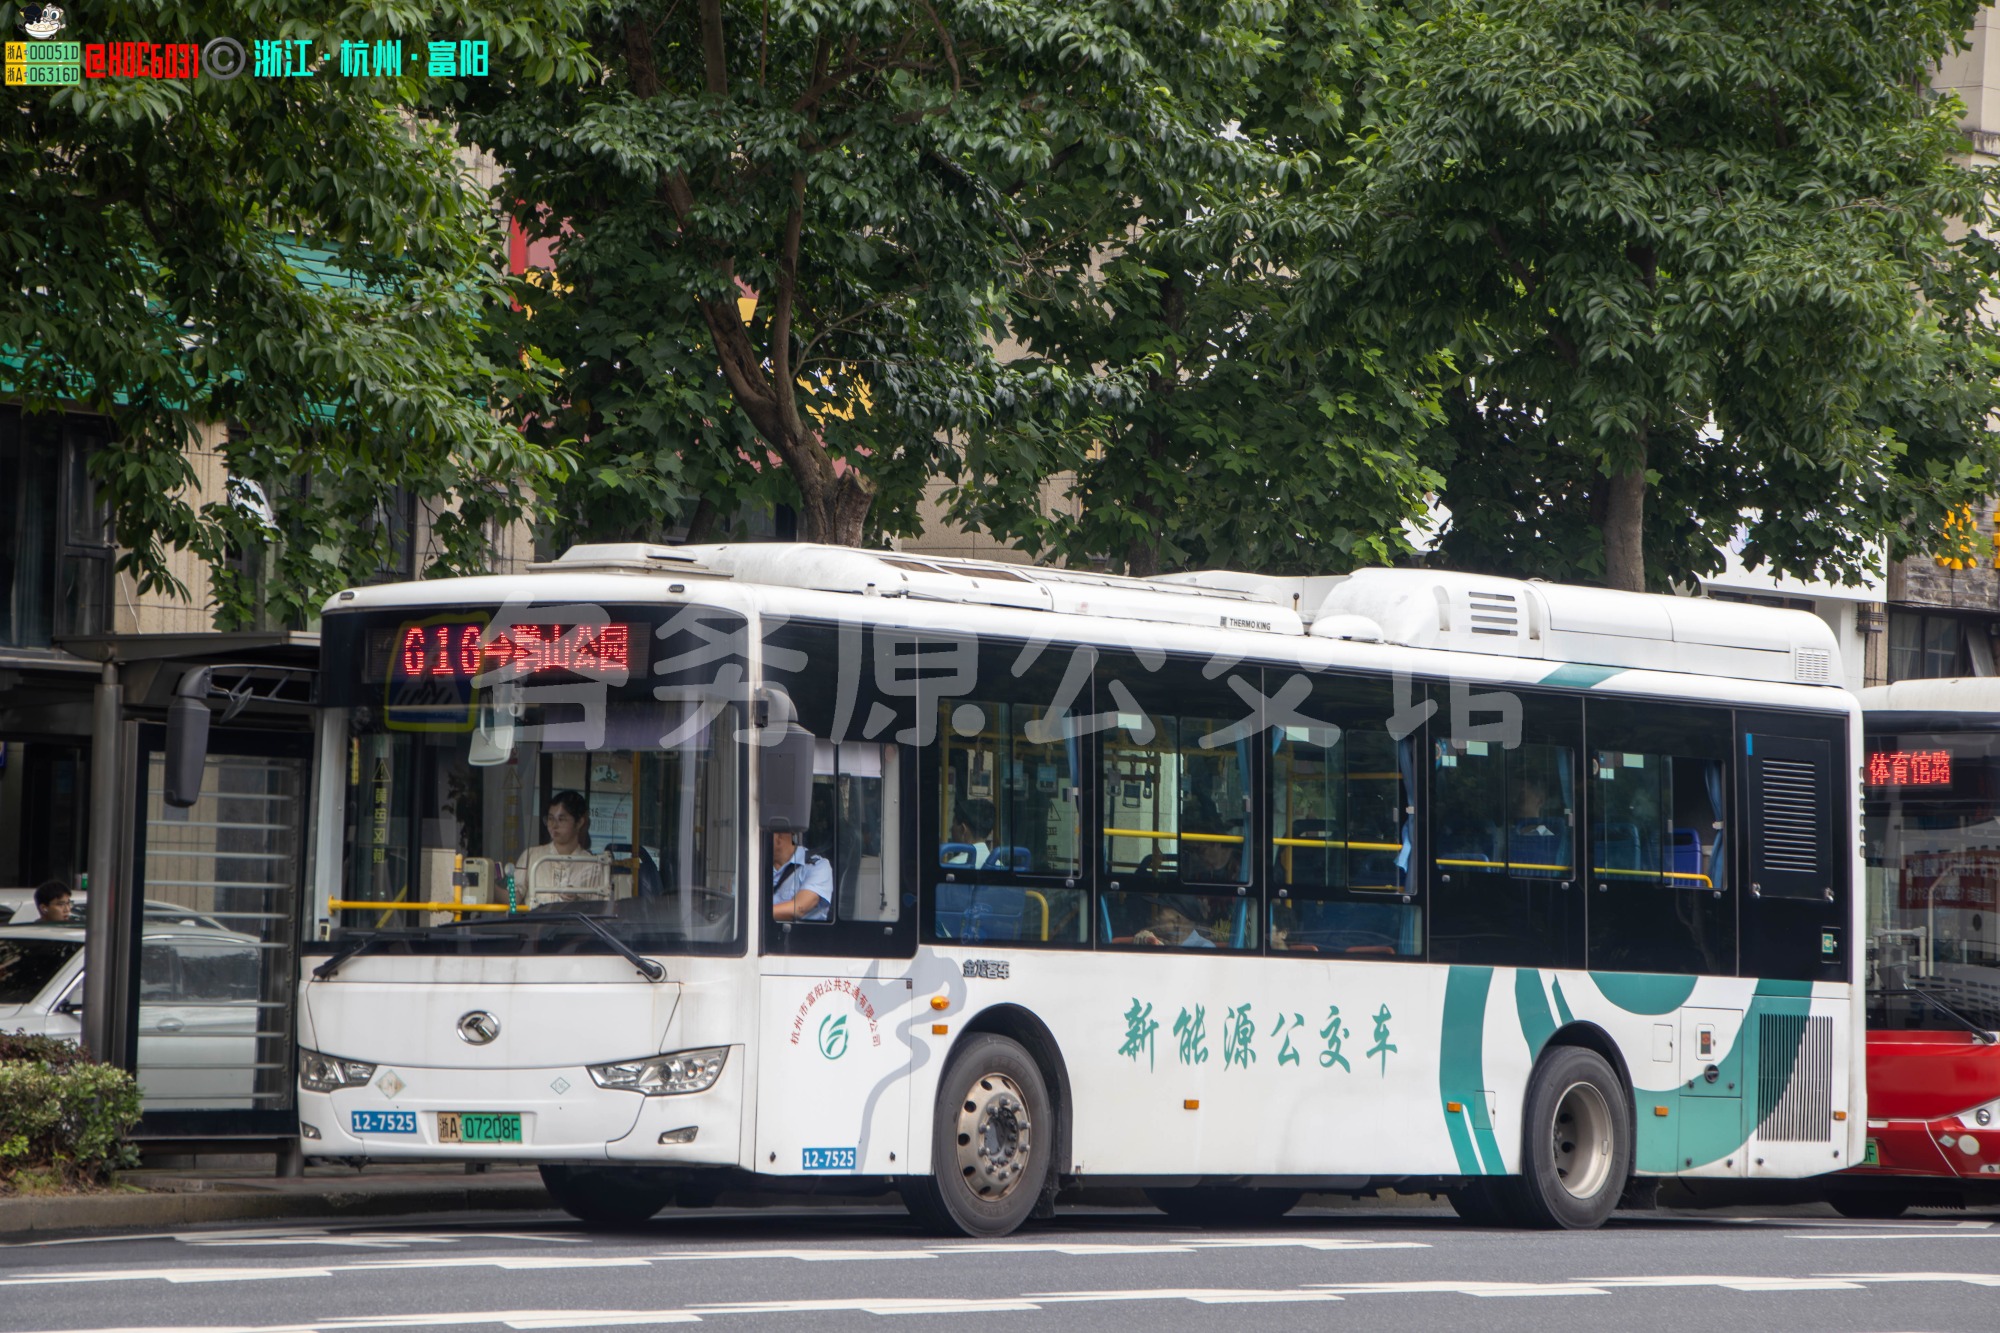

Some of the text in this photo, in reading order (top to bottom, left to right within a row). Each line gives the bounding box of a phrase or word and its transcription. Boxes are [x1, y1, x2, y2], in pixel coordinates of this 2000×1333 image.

[1230, 618, 1256, 629] THERMO
[1256, 621, 1271, 631] KING
[1869, 750, 1950, 785] 体育馆路
[962, 958, 1010, 979] 金龙客车
[1118, 996, 1398, 1079] 新能源公交车
[353, 1113, 415, 1132] 12-7525
[804, 1150, 854, 1168] 12-7525
